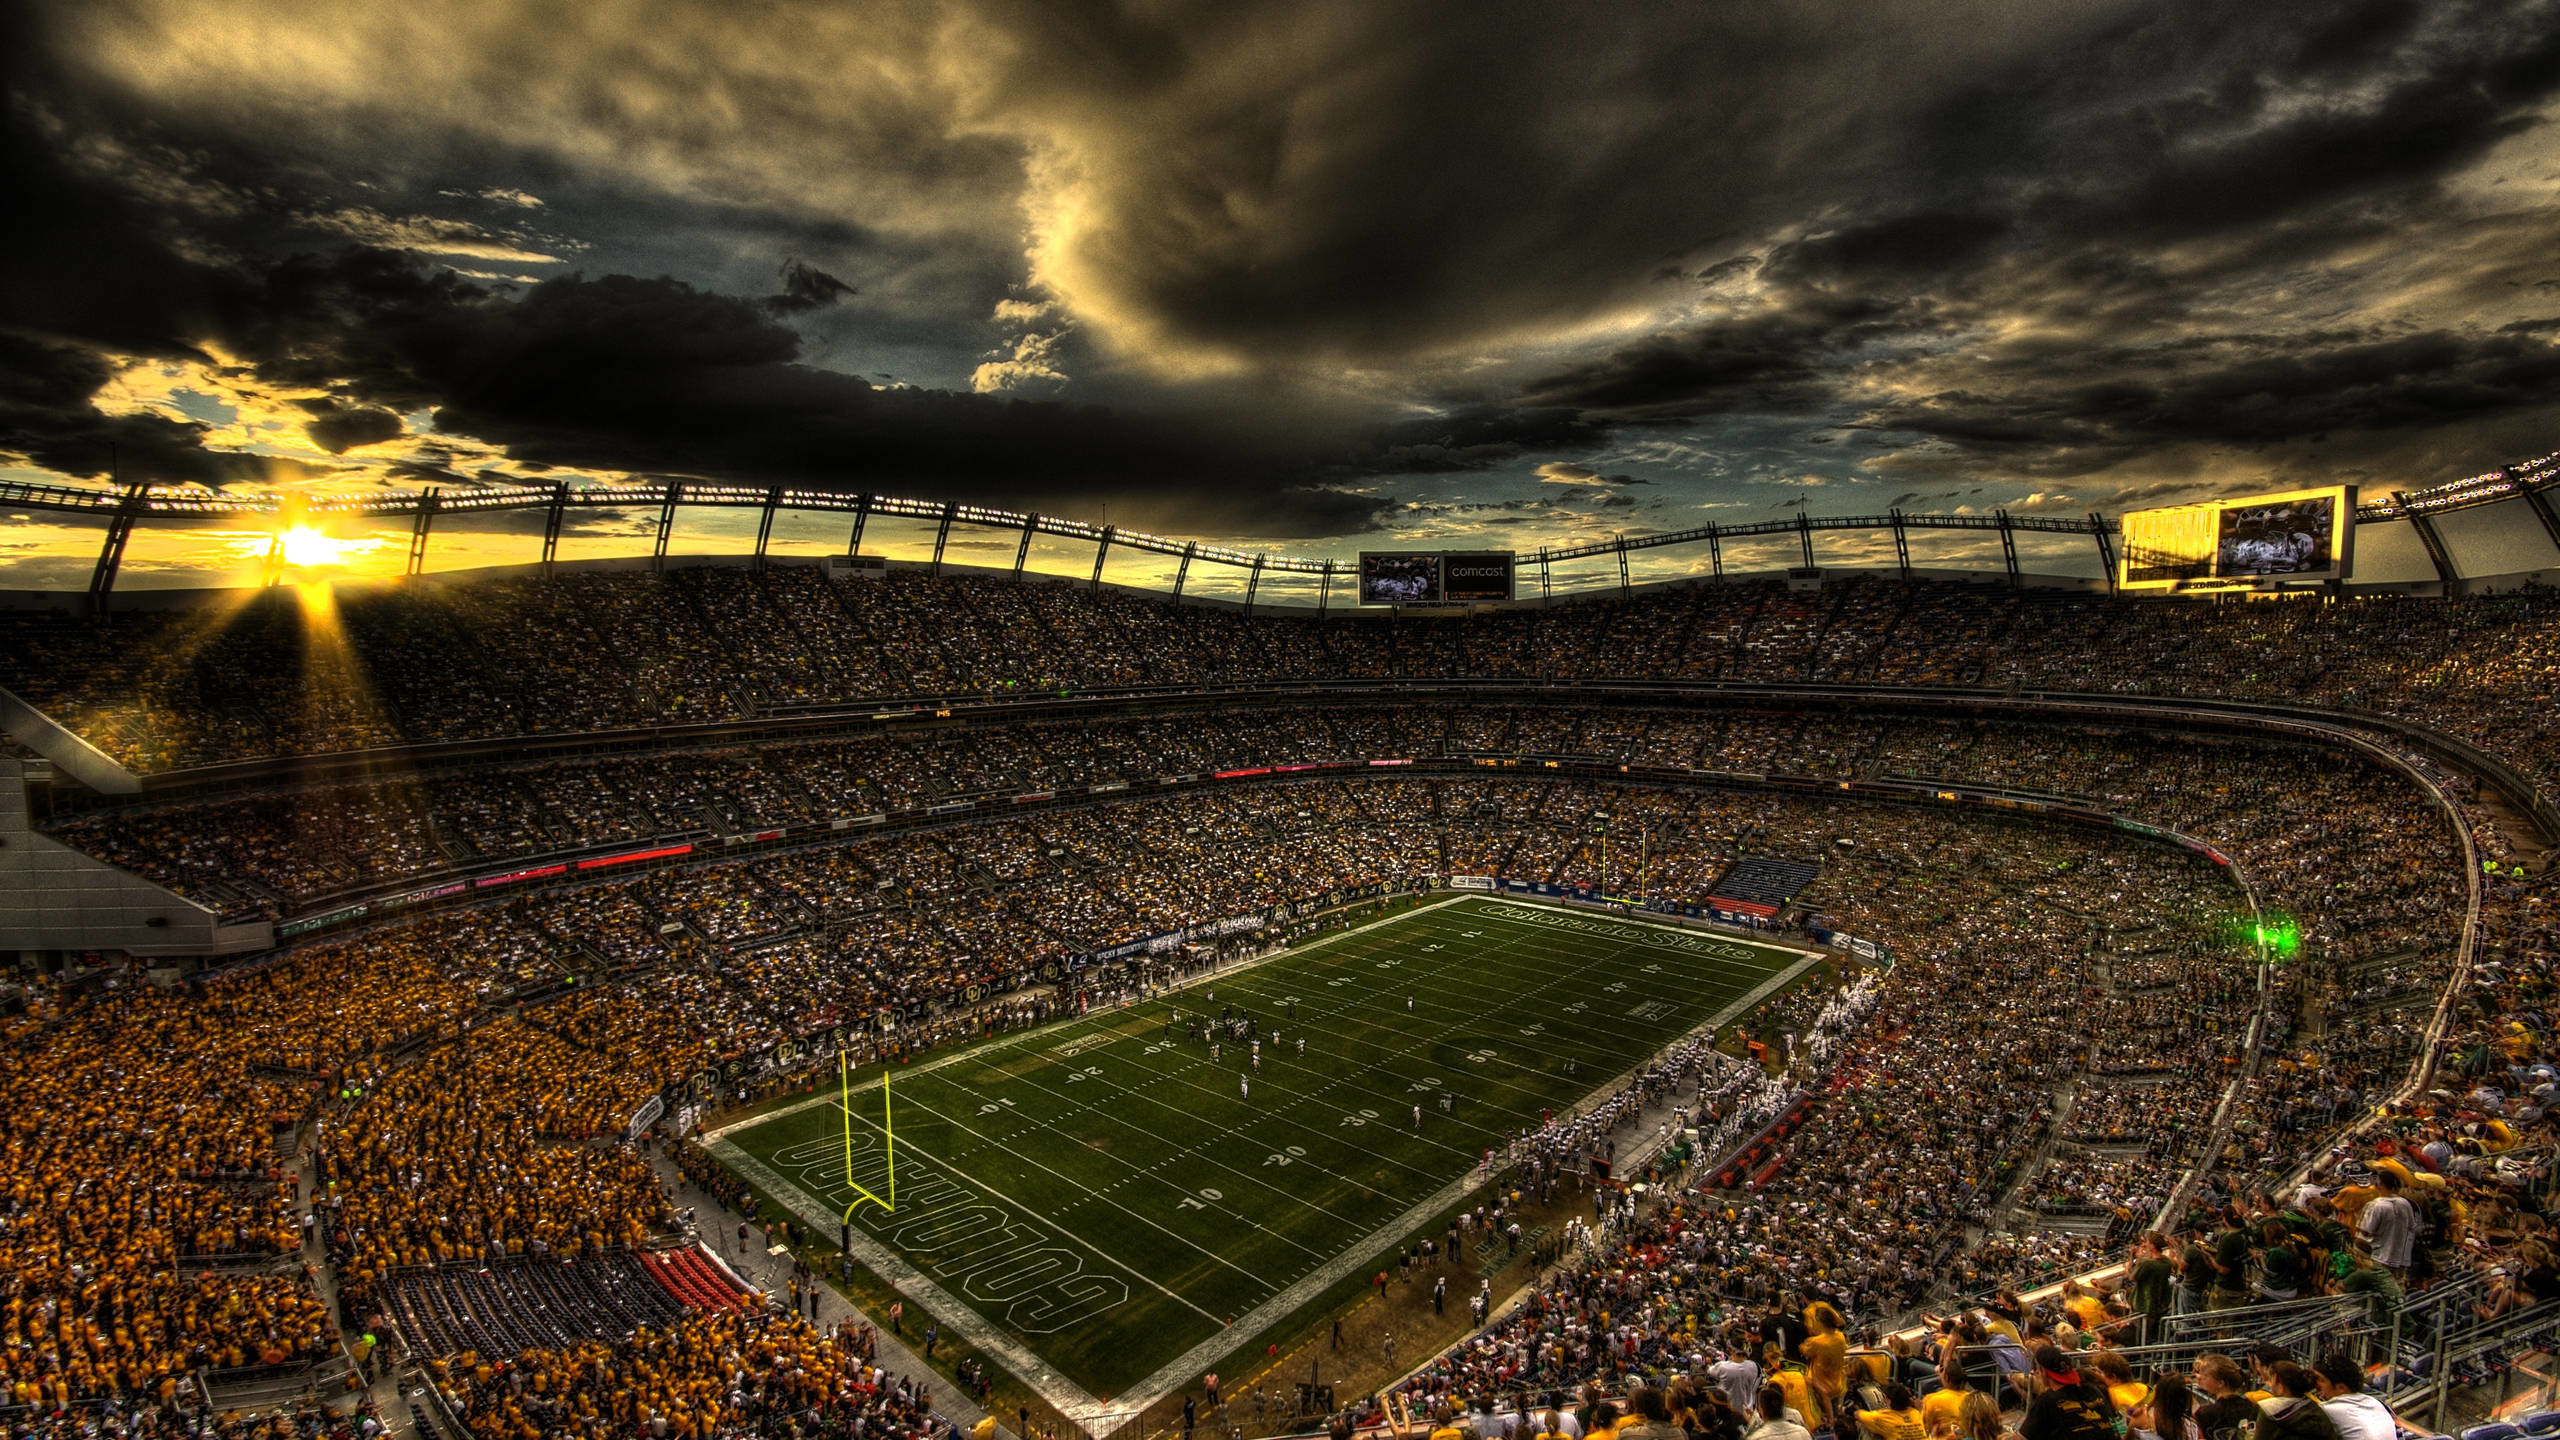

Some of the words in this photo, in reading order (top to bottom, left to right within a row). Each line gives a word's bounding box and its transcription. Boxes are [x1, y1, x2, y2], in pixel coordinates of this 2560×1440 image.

[1451, 566, 1505, 577] comcast
[1479, 904, 1648, 939] Colorado
[1096, 949, 1115, 961] ROCKY
[966, 984, 982, 1003] CU
[1466, 1049, 1498, 1063] 50
[1070, 1066, 1105, 1083] 20
[1410, 1076, 1443, 1093] 40
[980, 1097, 1018, 1114] 10
[1342, 1108, 1380, 1128] 30
[1267, 1146, 1307, 1167] 20
[1180, 1188, 1224, 1211] 10
[771, 1131, 1130, 1334] COLORADO
